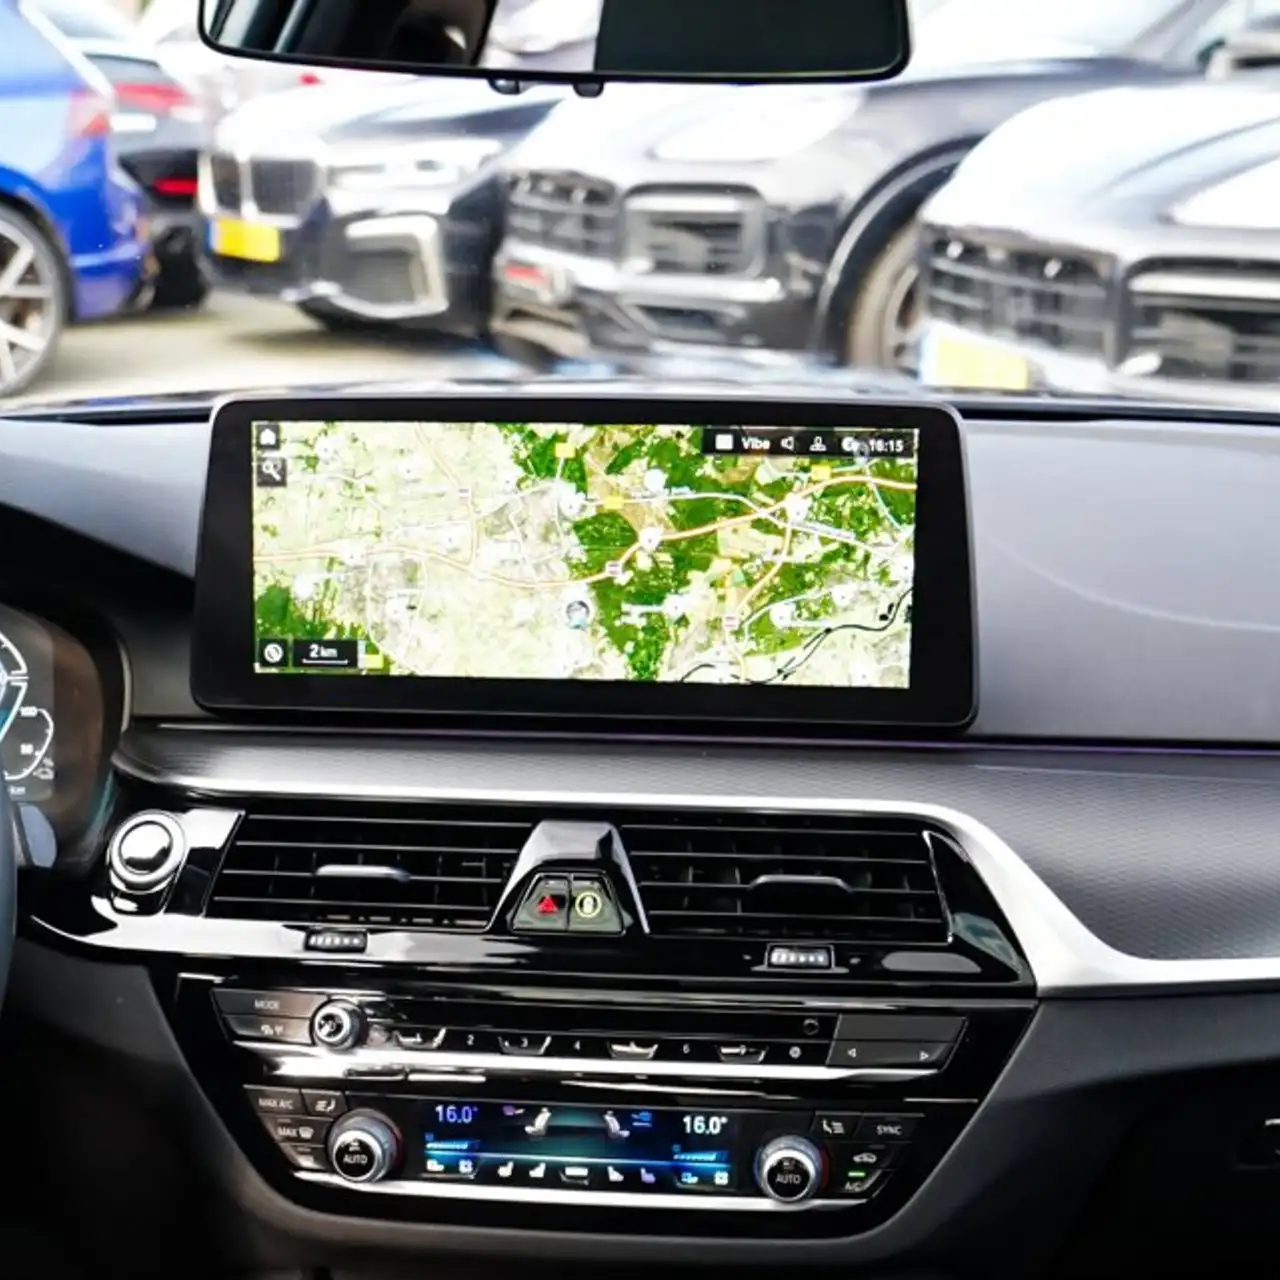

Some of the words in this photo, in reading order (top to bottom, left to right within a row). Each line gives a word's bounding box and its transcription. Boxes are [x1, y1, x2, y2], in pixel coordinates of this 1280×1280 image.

[741, 436, 771, 450] Vibe
[869, 438, 905, 453] 16:15
[309, 643, 319, 659] 2
[320, 646, 338, 658] km
[259, 1098, 277, 1108] MAX
[278, 1099, 294, 1110] A/C
[683, 1114, 728, 1135] 16.0°
[876, 1124, 903, 1136] SYNC
[277, 1127, 298, 1138] MAX
[342, 1154, 369, 1166] AUTO
[775, 1173, 802, 1185] AUTO
